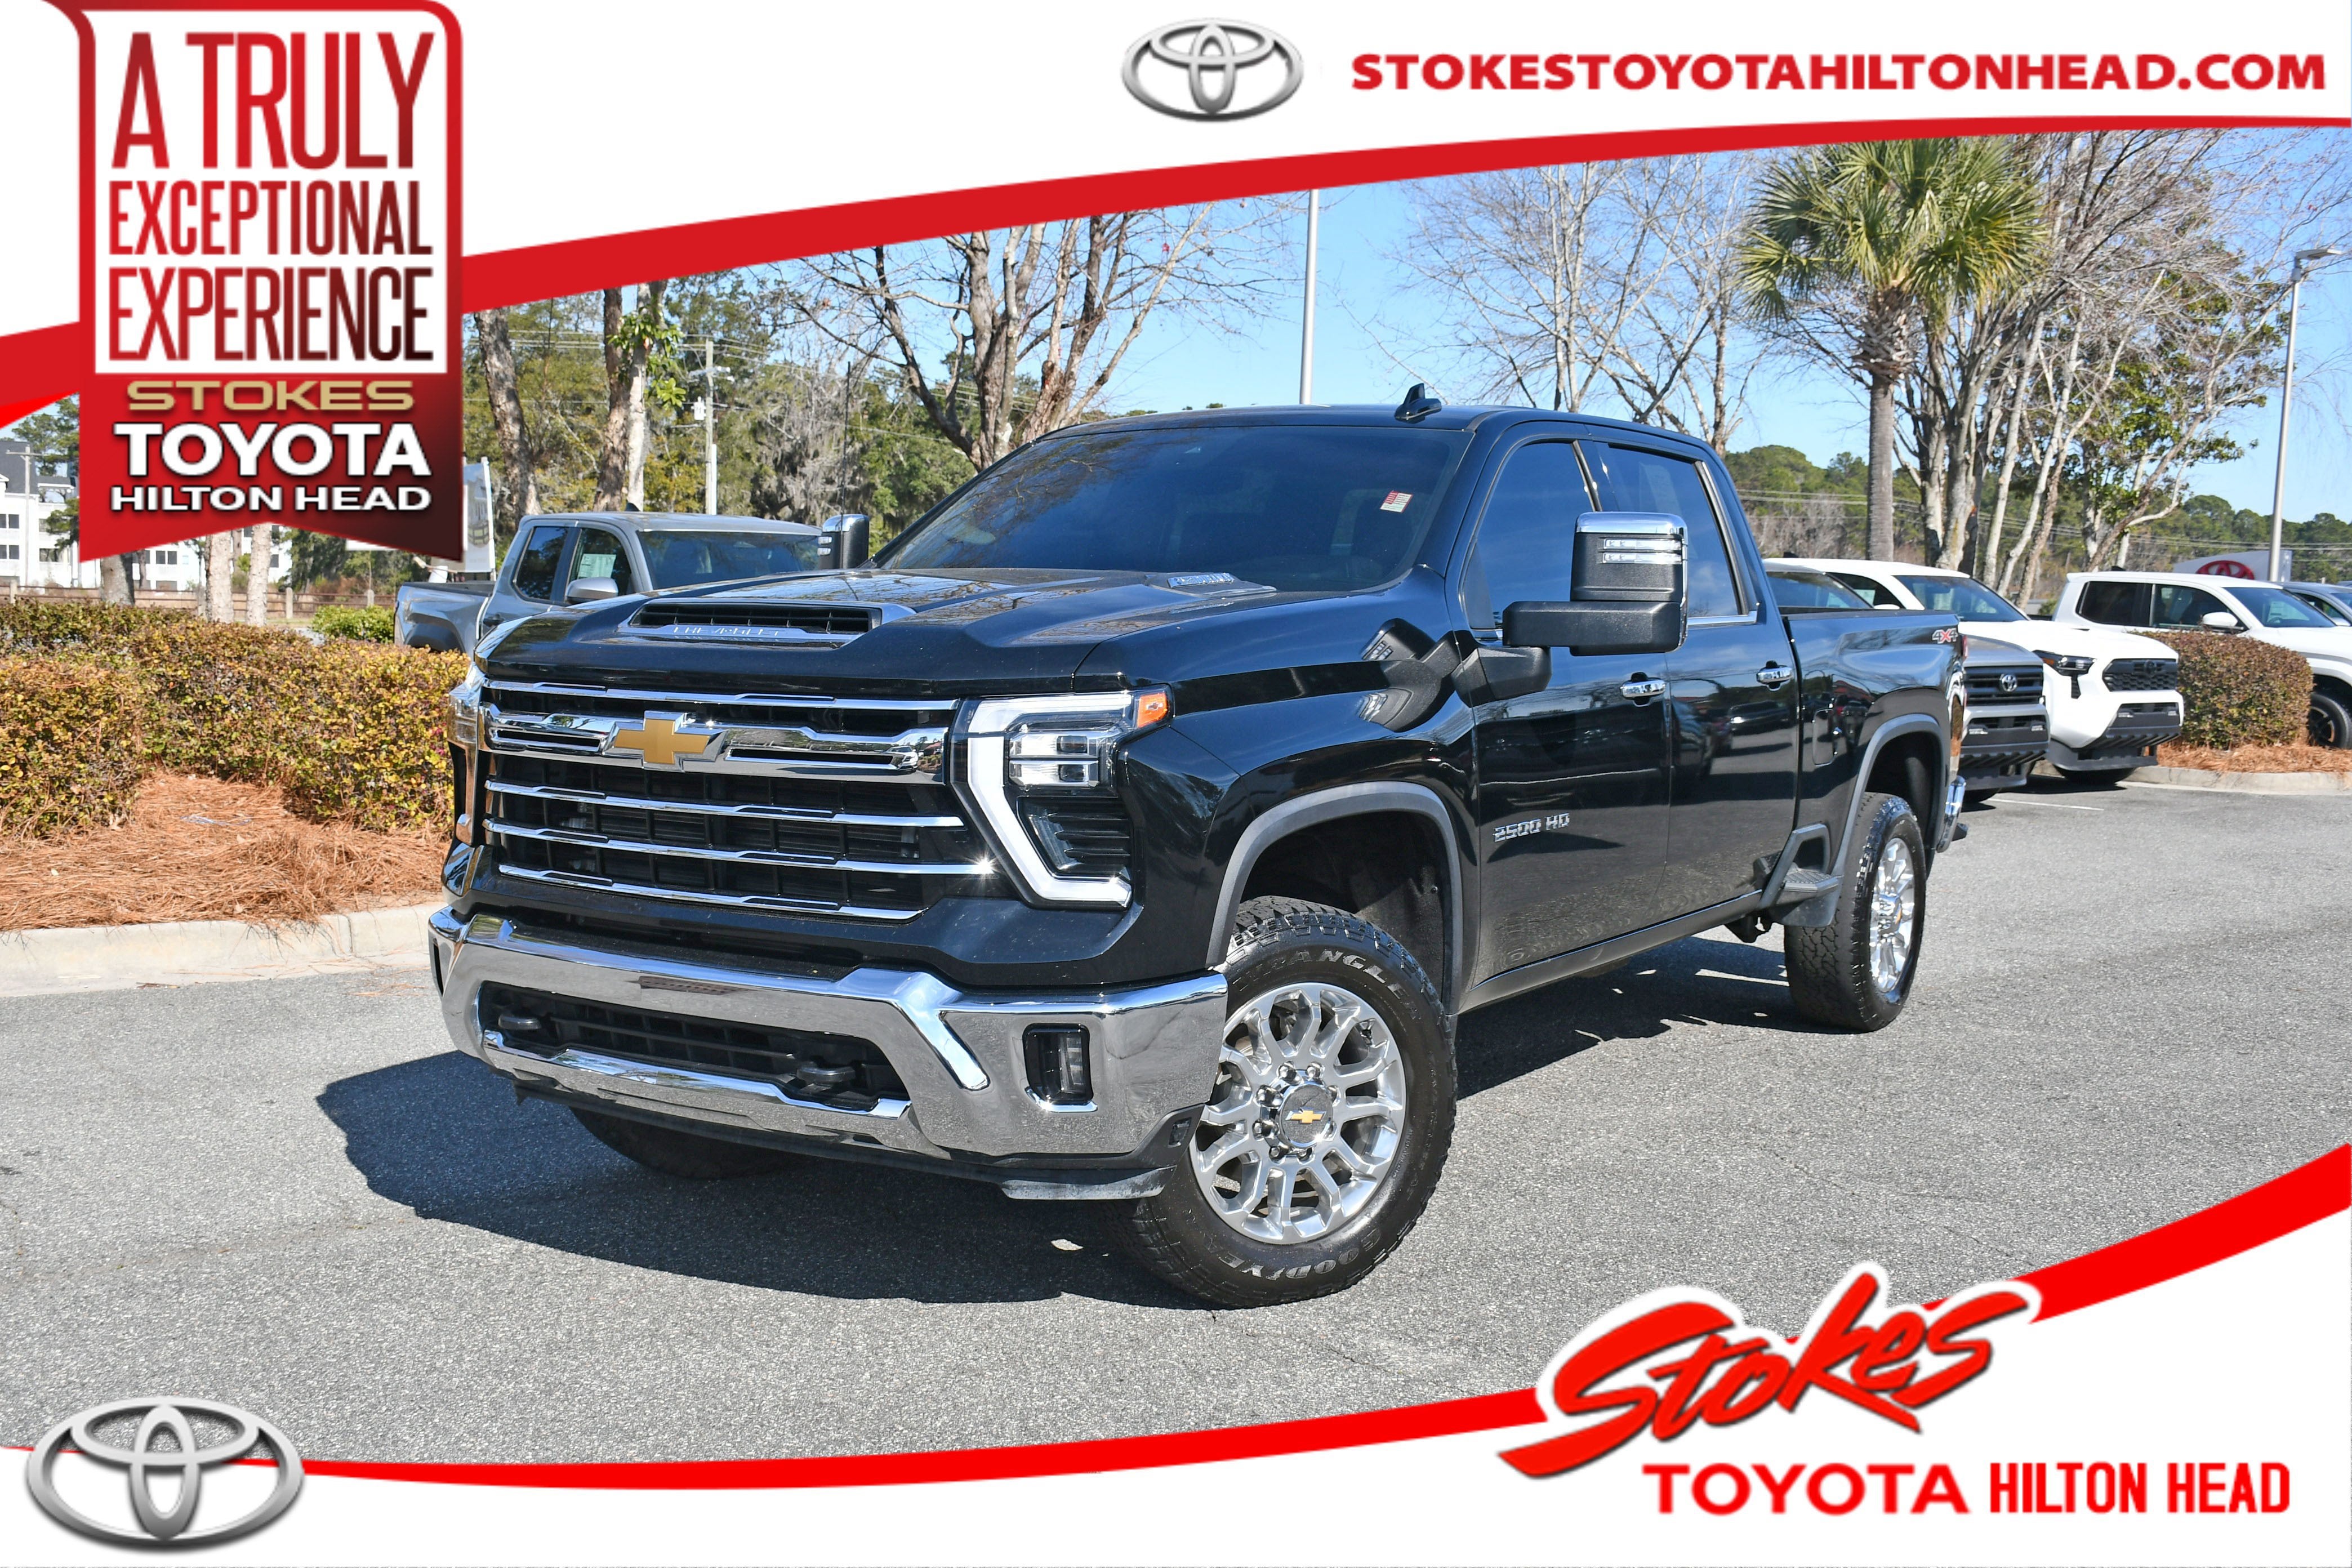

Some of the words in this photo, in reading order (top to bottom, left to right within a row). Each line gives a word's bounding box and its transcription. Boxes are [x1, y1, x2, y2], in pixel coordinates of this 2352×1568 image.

[673, 627, 786, 637] HEVROLET
[1493, 818, 1542, 842] 2500
[1545, 813, 1570, 831] HD
[1232, 948, 1423, 1021] ANGLER
[1182, 1208, 1382, 1281] GOODYEA
